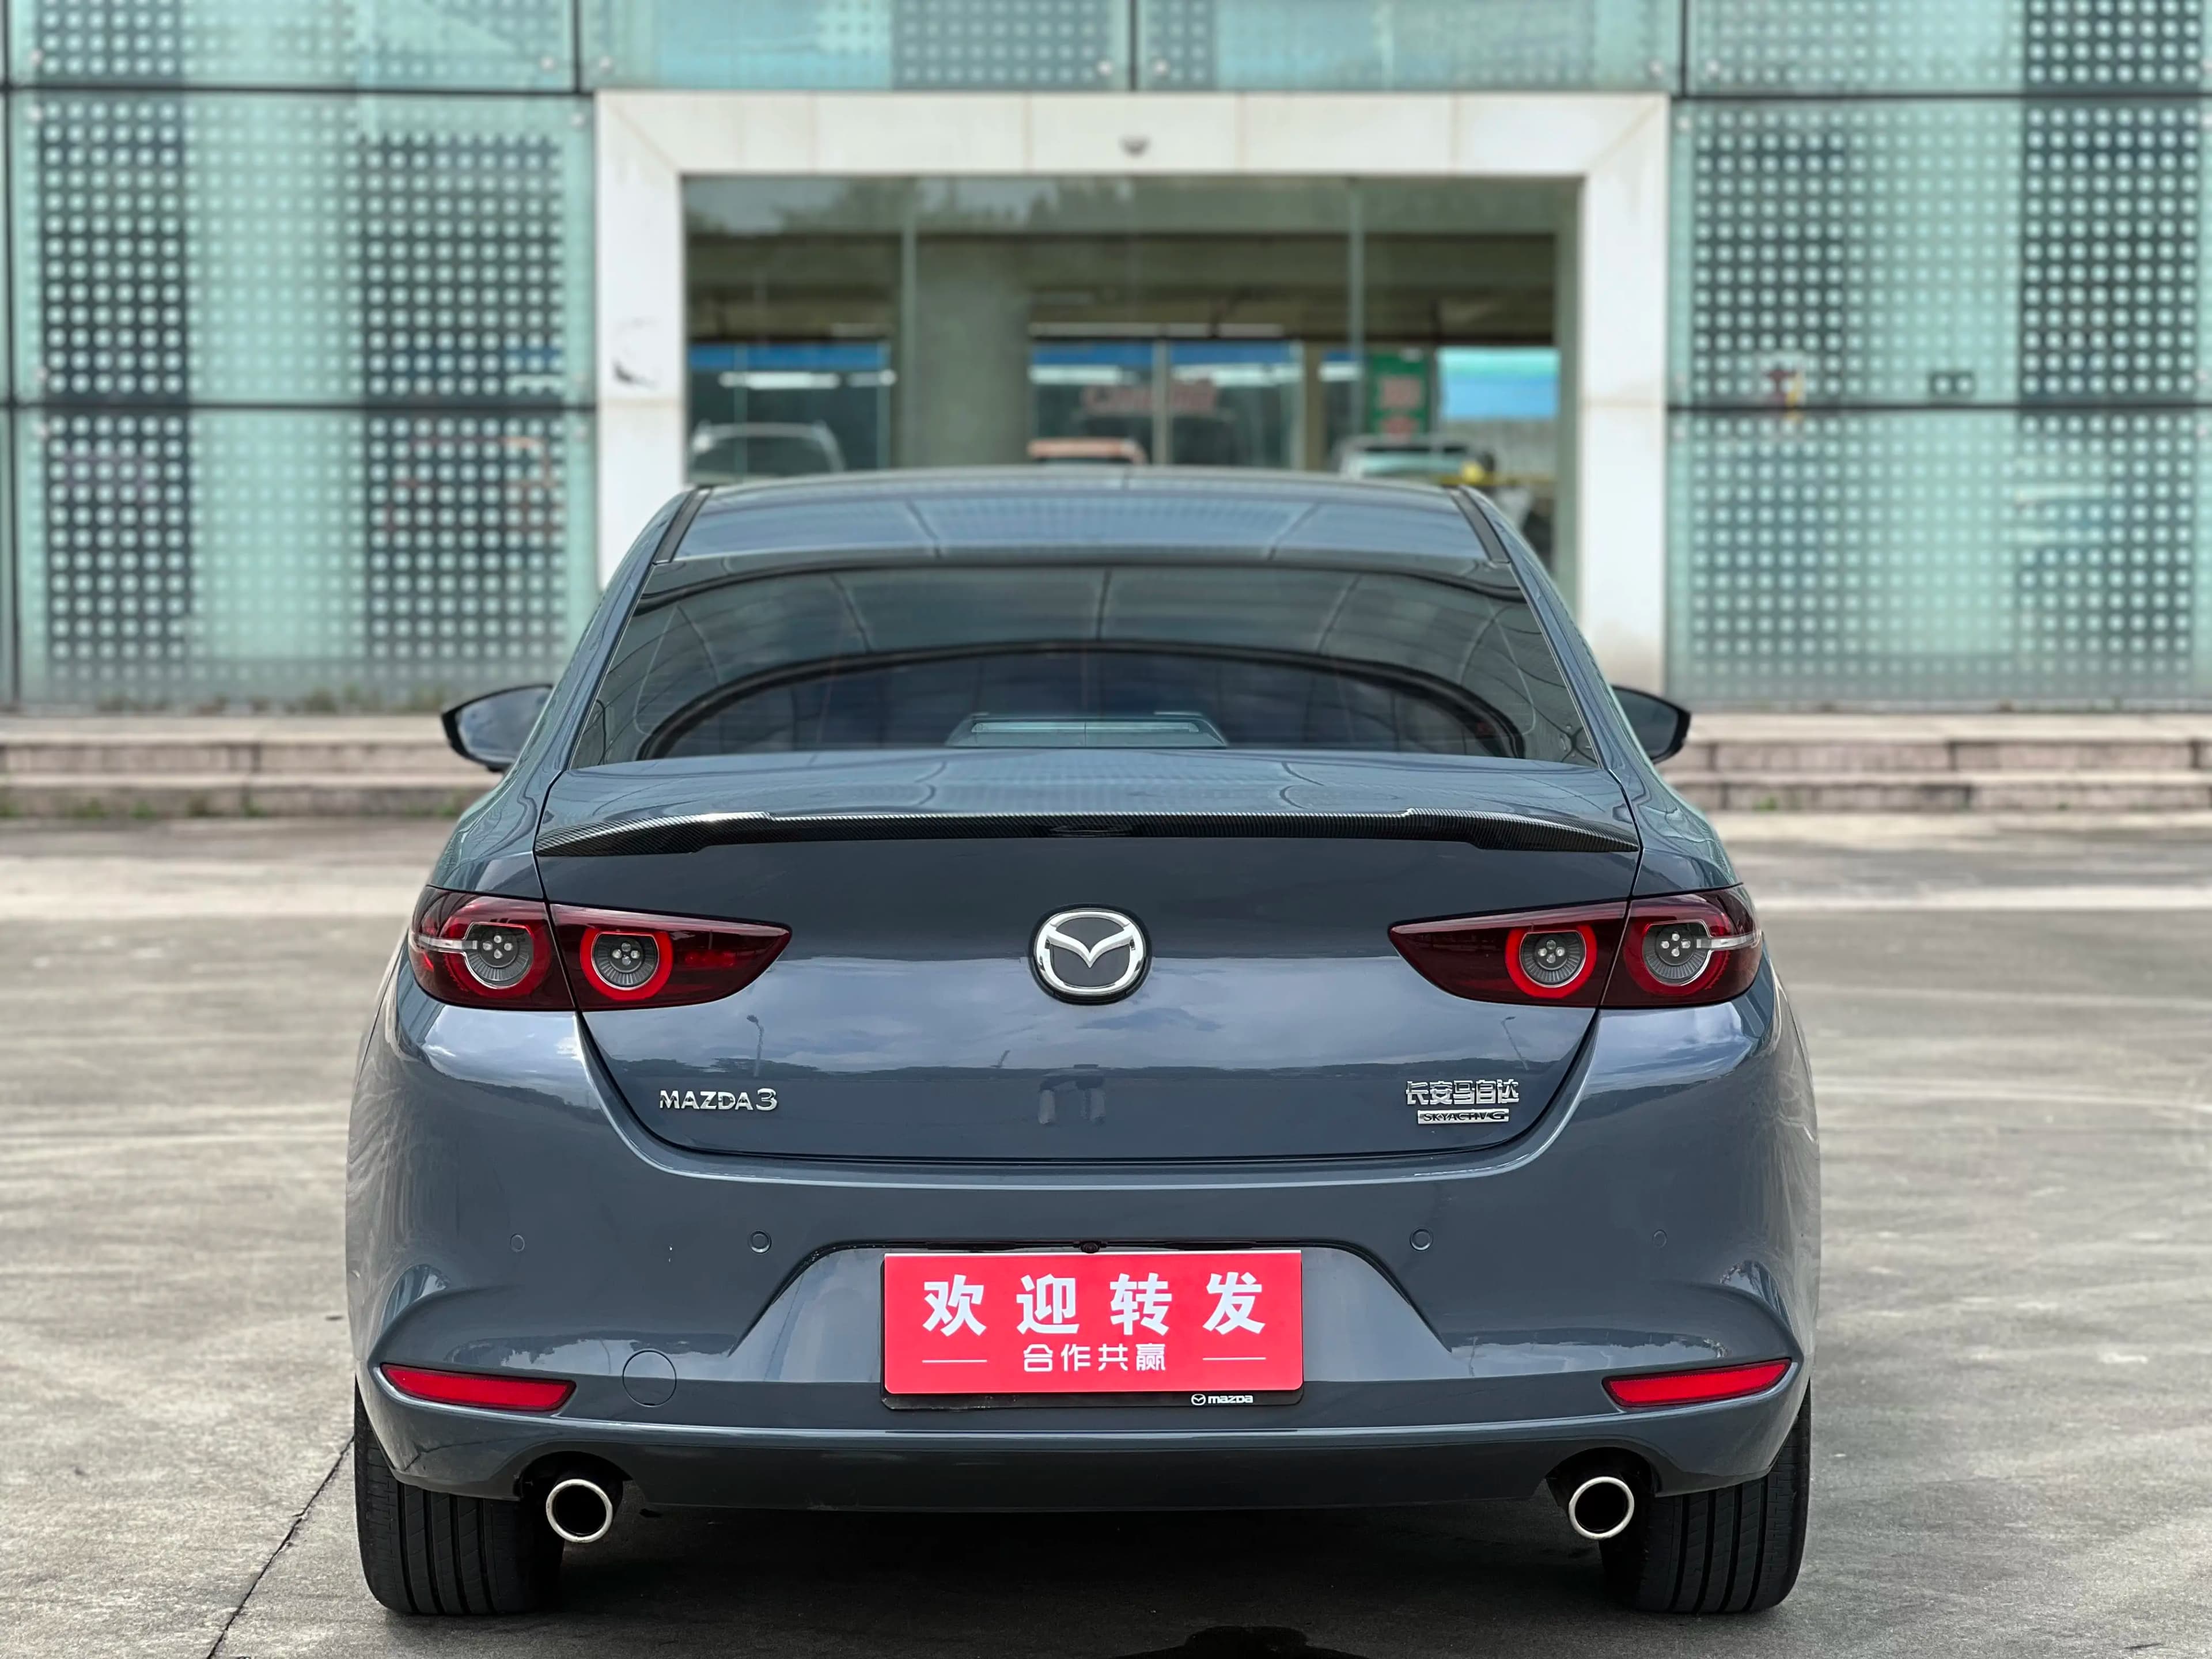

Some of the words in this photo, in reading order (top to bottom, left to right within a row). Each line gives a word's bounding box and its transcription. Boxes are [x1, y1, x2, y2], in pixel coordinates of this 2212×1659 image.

[1406, 1079, 1520, 1105] 长安马自达
[923, 1272, 1266, 1336] 欢迎转发
[1023, 1343, 1166, 1372] 合作共赢
